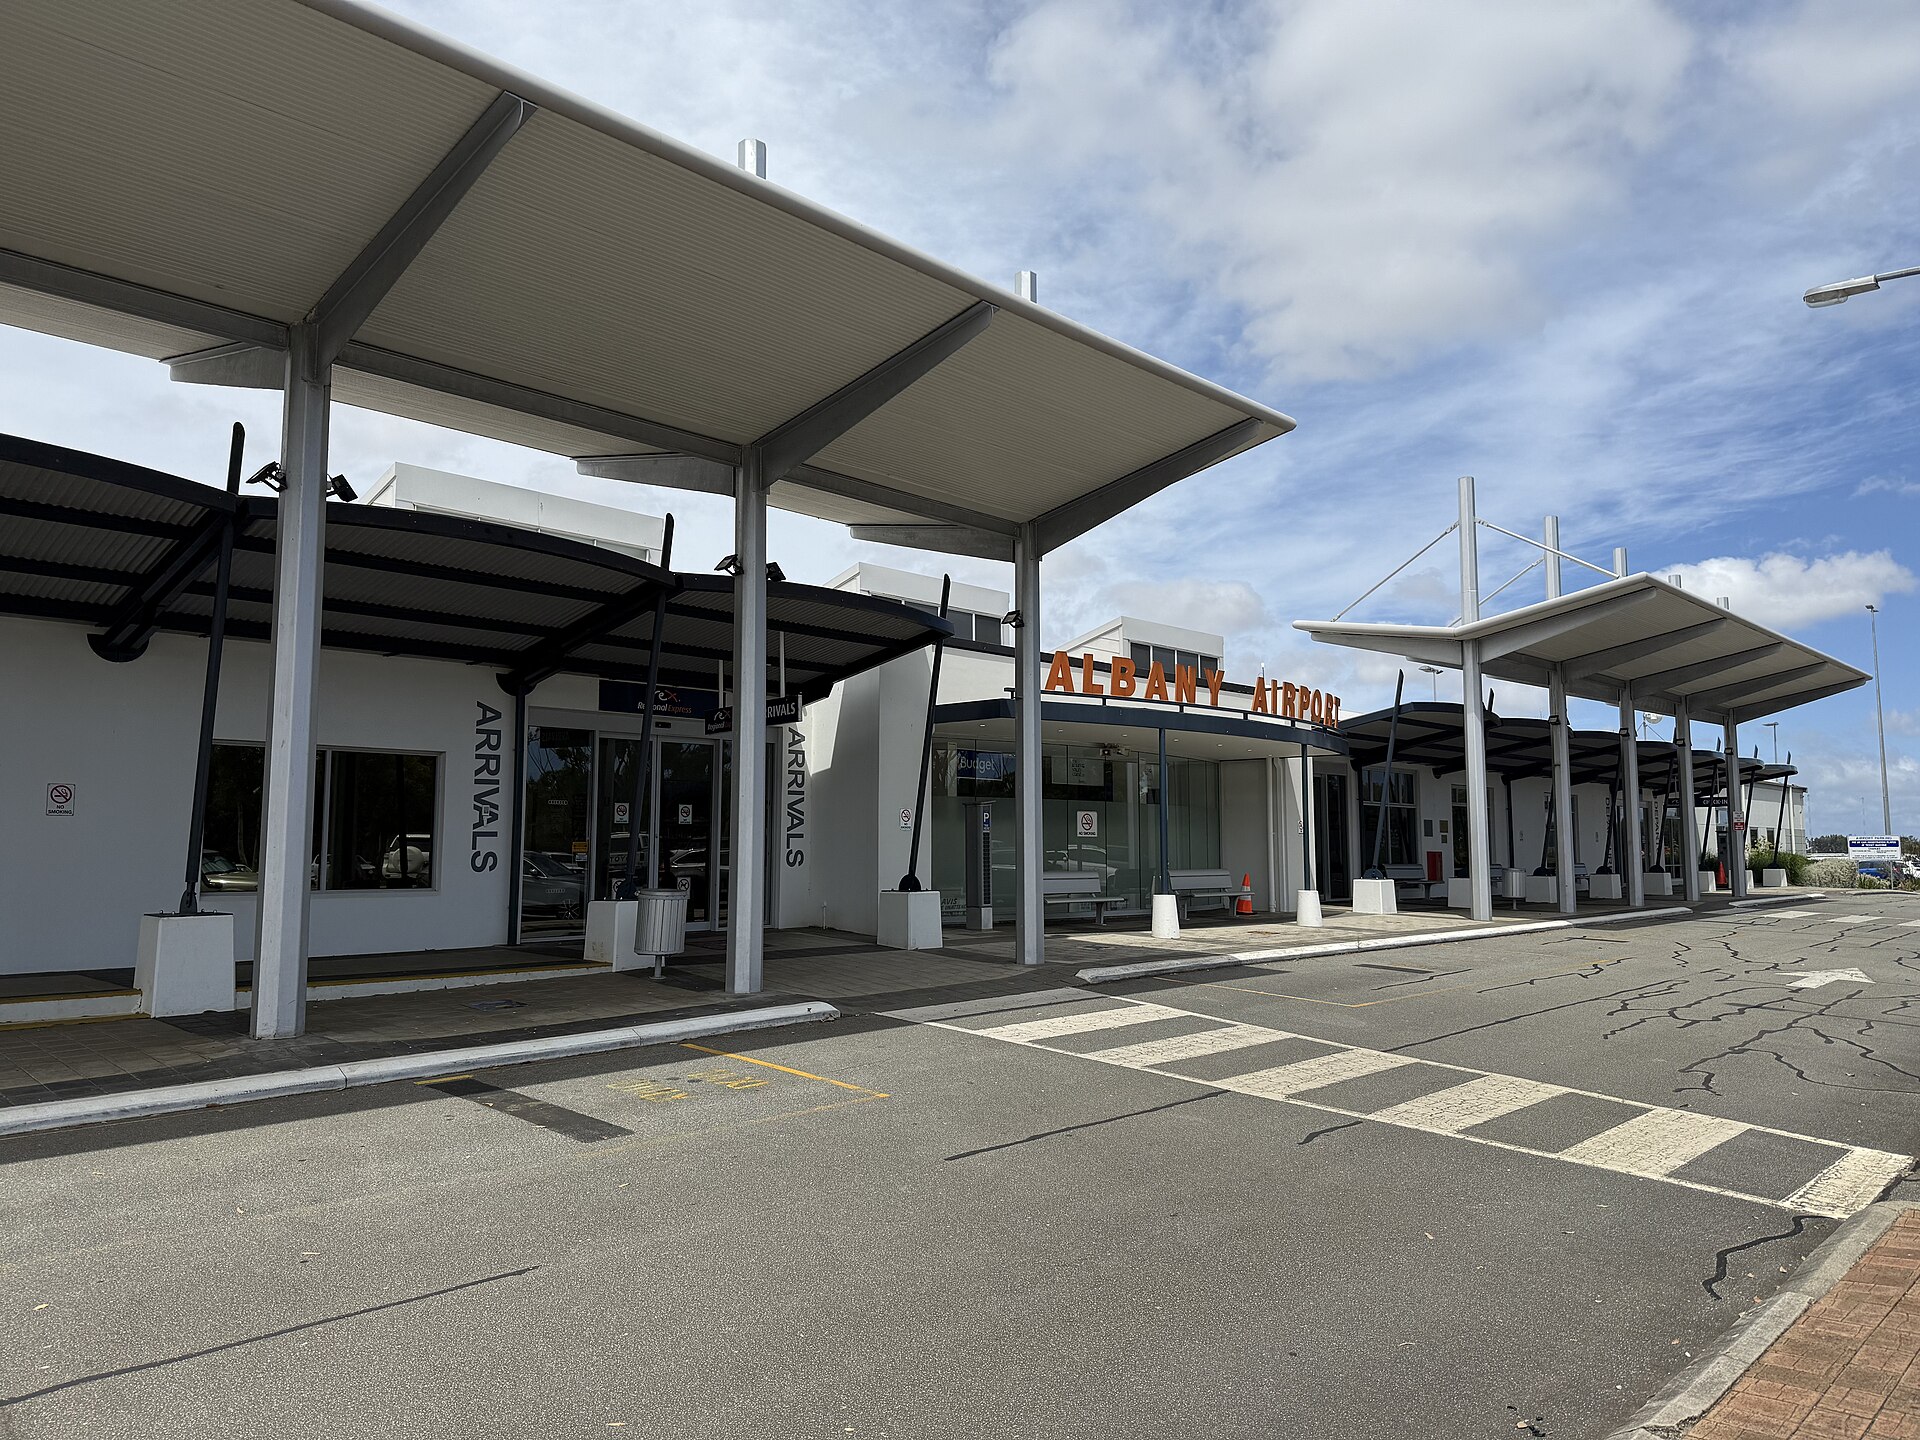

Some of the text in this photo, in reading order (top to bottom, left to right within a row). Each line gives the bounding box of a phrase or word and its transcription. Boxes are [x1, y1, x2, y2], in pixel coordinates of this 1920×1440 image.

[1045, 650, 1341, 729] ALBANY AIRPORT
[637, 701, 692, 714] Reonal Express
[767, 702, 796, 718] RIVALS
[960, 756, 995, 774] Budget
[471, 700, 502, 873] ARRIVALS
[785, 726, 806, 868] ARRIVALS
[983, 812, 990, 823] P
